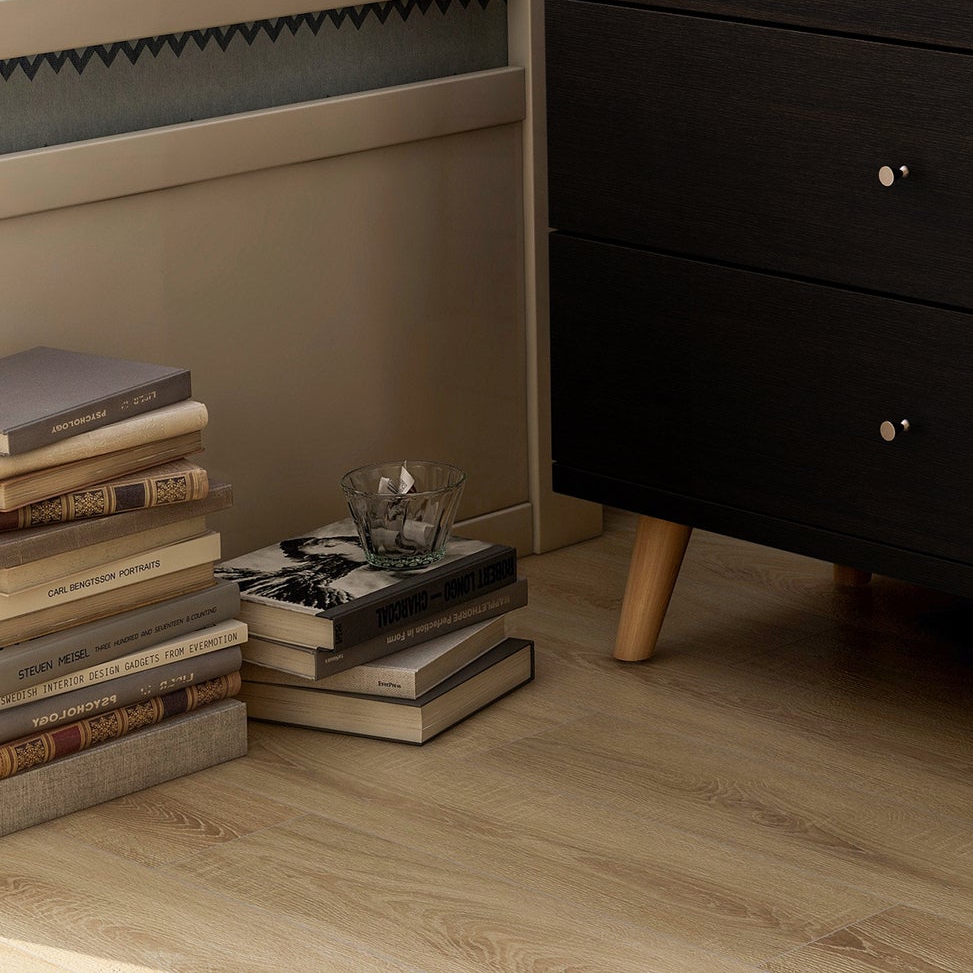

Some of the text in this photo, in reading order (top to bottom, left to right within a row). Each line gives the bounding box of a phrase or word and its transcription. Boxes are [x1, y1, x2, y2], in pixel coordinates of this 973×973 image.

[51, 410, 106, 434] PSYCHOLOGY
[48, 560, 161, 598] CARL BENGTSSON PORTRAITS
[444, 573, 475, 603] LONGO
[477, 556, 515, 590] ROBERT
[375, 591, 429, 629] CHARCOAL
[386, 595, 511, 645] MAPPLETHORPE Perfection in Form
[1, 632, 238, 705] SWEDISH INTERIOR DESIGN GADGETS FROM EVERMOTION
[18, 660, 53, 679] STEVEN
[58, 648, 90, 666] MEISEL
[95, 643, 111, 653] THREE
[114, 633, 139, 647] HUNDRED
[141, 628, 153, 638] AND
